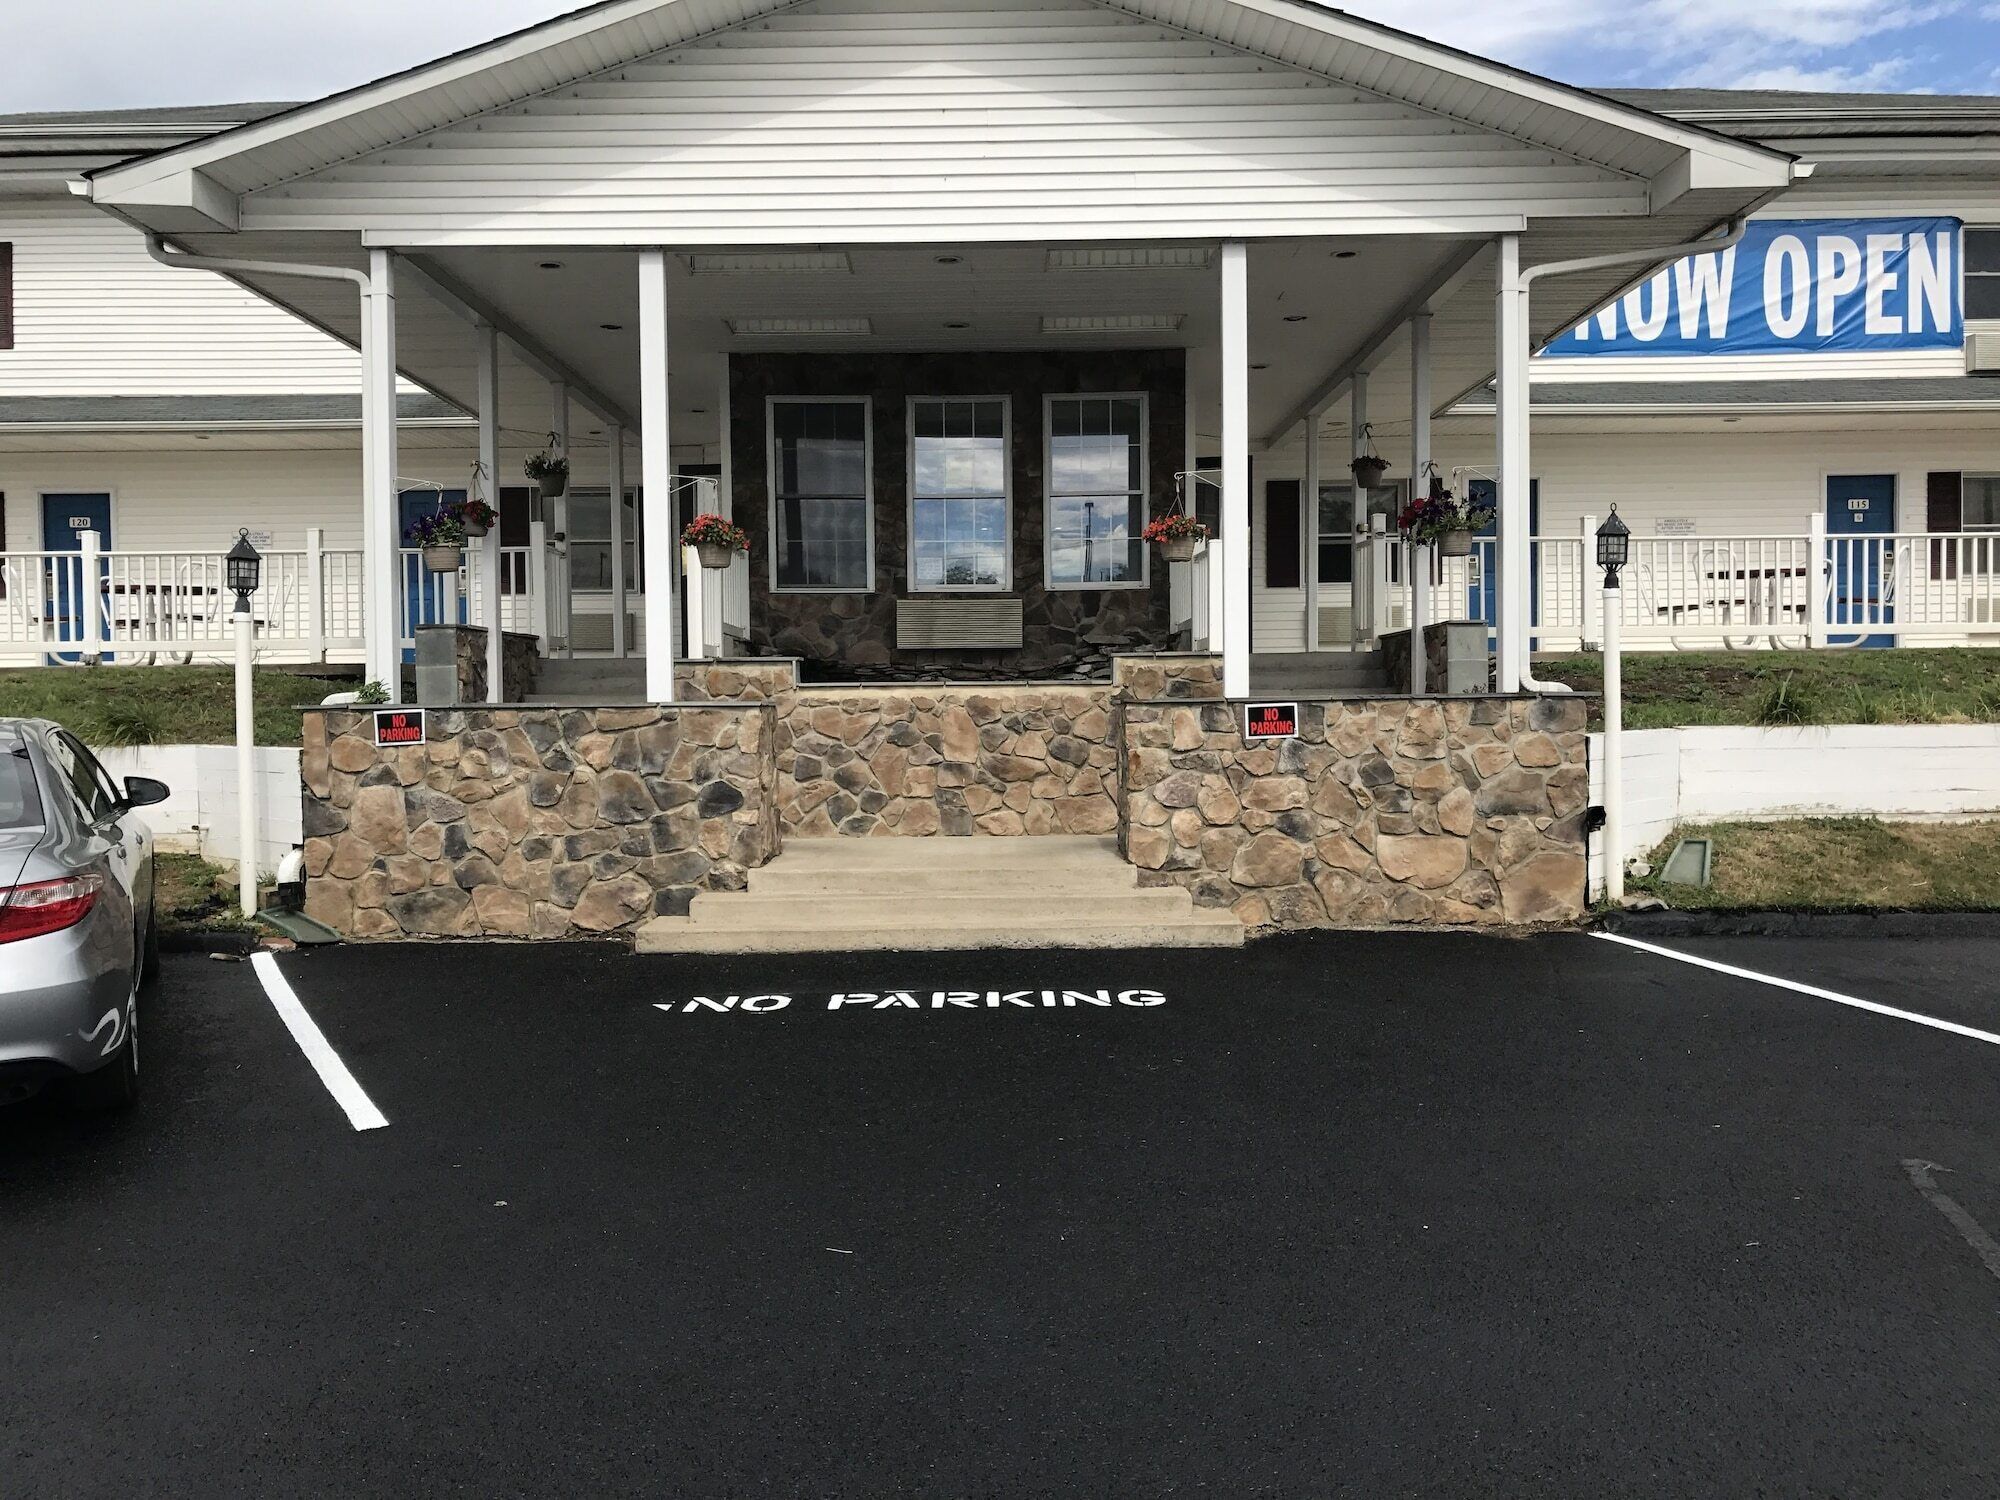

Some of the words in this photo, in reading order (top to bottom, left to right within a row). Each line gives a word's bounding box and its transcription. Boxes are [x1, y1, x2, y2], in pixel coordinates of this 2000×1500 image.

[1575, 246, 1736, 342] OW
[1763, 231, 1951, 339] OPEN
[1850, 500, 1867, 509] 115
[72, 518, 88, 527] 120
[392, 714, 407, 727] NO
[1263, 708, 1279, 721] NO
[380, 726, 420, 741] PARKING
[1250, 720, 1293, 735] PARKING
[682, 994, 792, 1013] NO
[827, 990, 1167, 1010] PARKING
